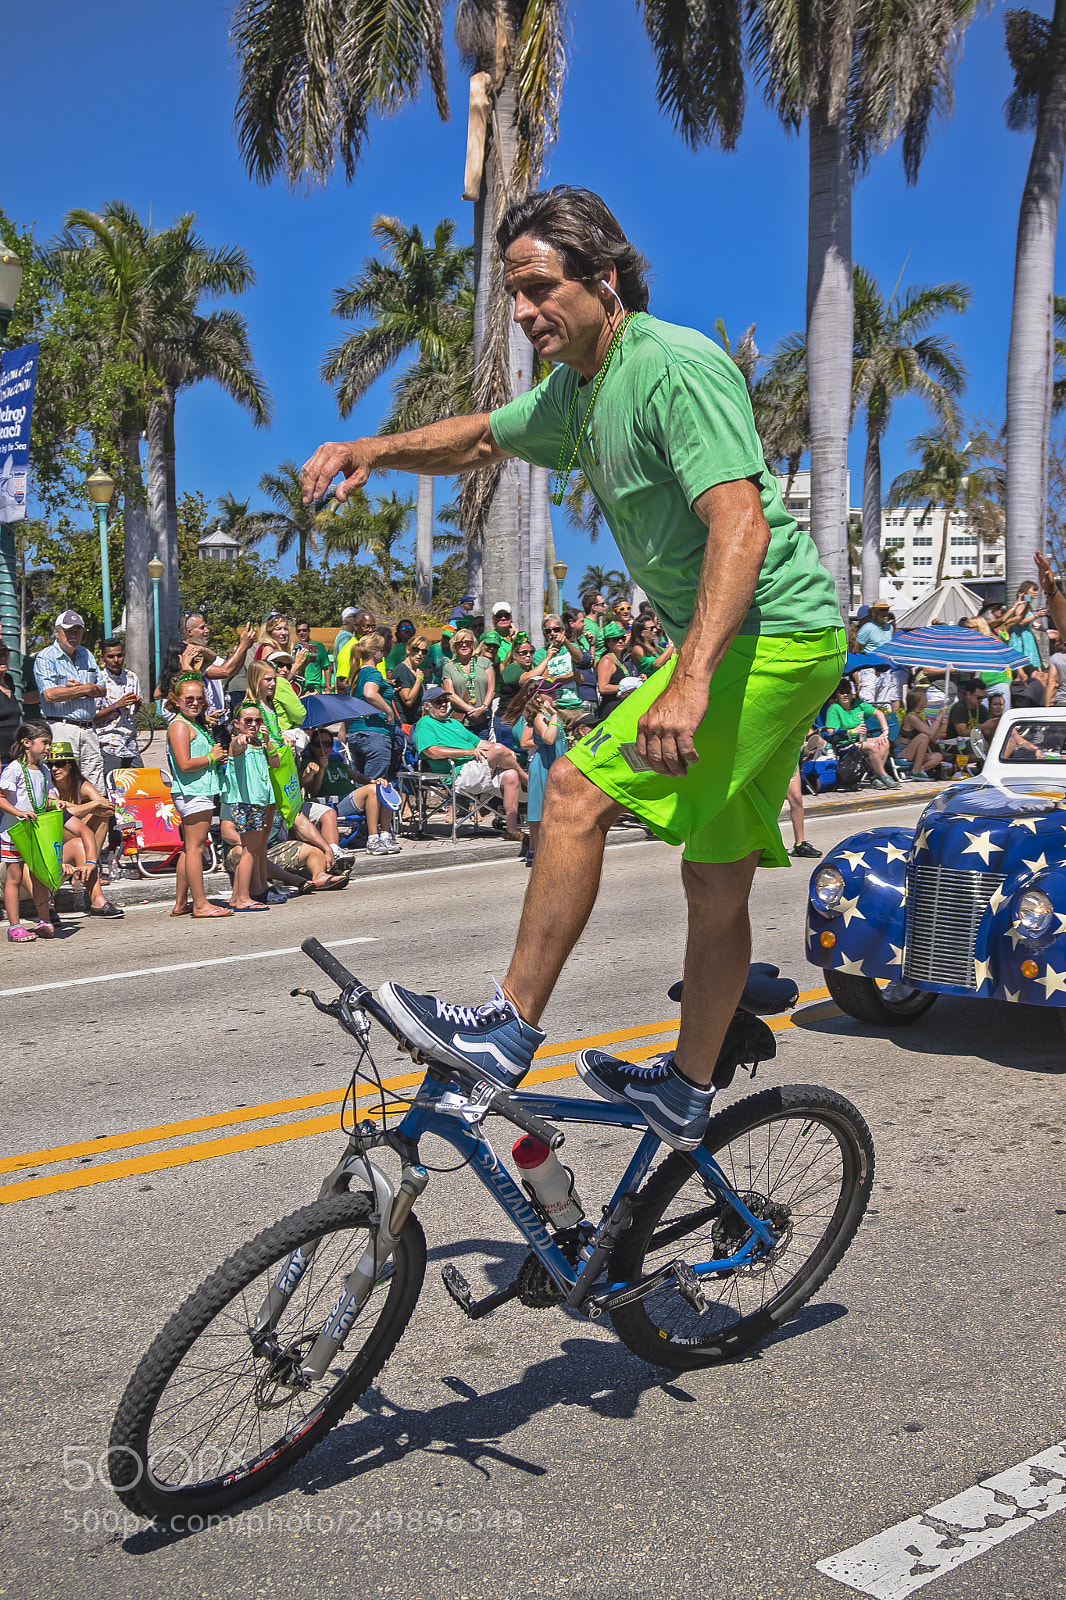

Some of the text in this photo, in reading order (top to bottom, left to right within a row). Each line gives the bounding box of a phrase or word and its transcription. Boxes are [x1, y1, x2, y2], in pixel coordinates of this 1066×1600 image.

[0, 405, 26, 423] elray
[0, 421, 21, 439] each
[14, 441, 27, 450] Sea
[477, 1153, 554, 1250] SPECIALIZED
[277, 1247, 308, 1296] FOX
[330, 1294, 361, 1341] FOX
